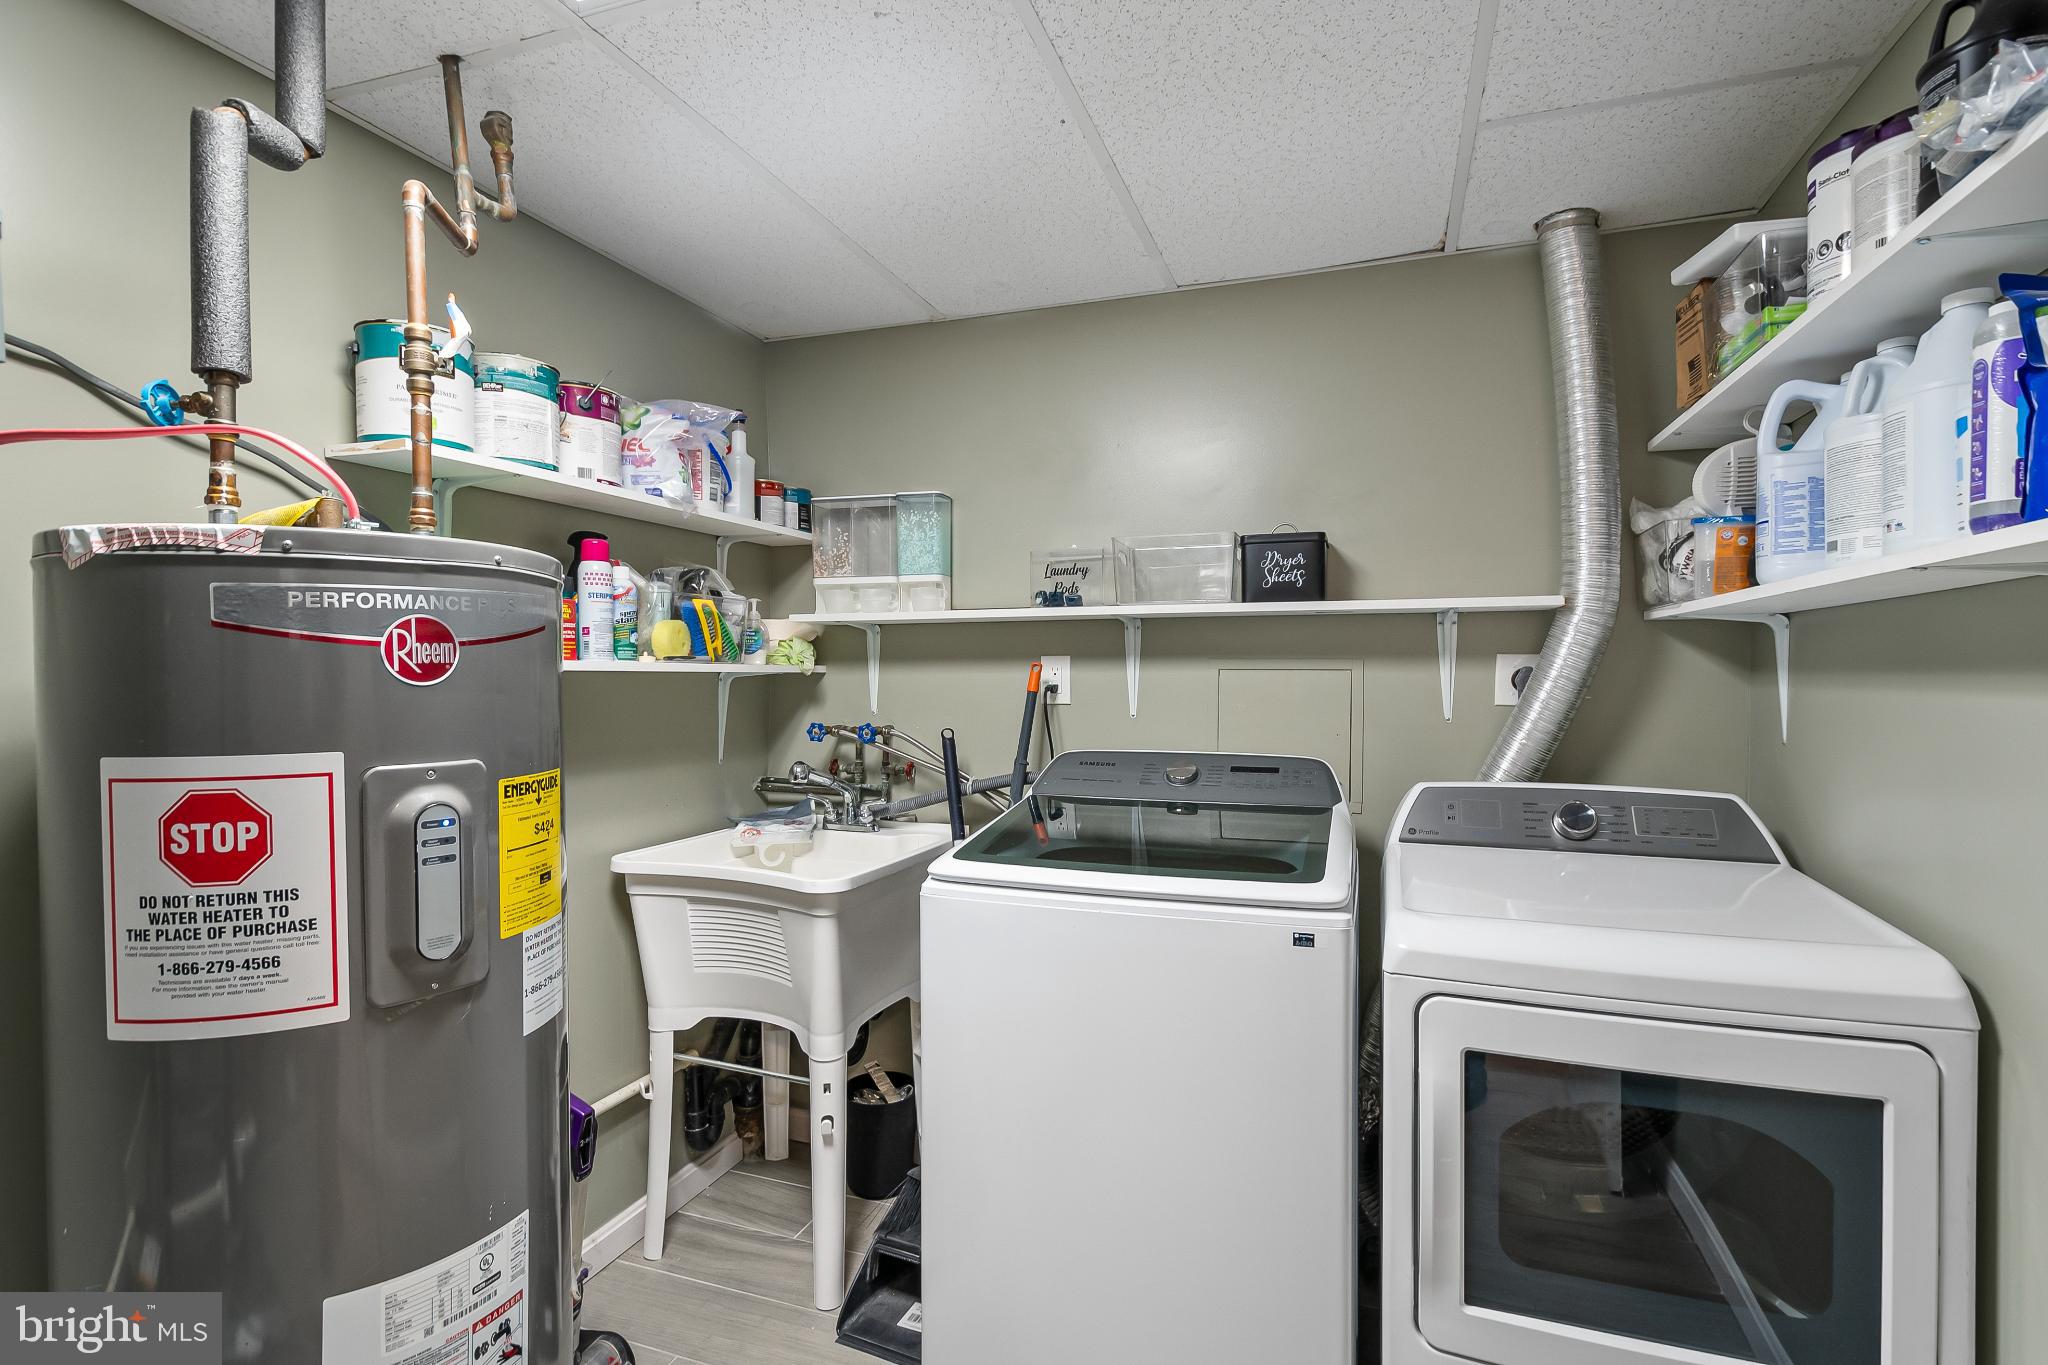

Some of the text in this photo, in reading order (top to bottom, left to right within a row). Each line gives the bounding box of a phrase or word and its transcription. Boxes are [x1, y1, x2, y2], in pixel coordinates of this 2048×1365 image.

[1818, 168, 1850, 186] Sani-Clot
[1044, 562, 1089, 580] Laundry
[1261, 551, 1306, 572] Dryer
[1263, 565, 1306, 587] Sheets
[1052, 581, 1080, 597] Pods
[287, 591, 473, 612] PERFORMANCE
[392, 618, 455, 673] Rheem
[504, 775, 558, 799] ENERGYGUIDE
[534, 817, 554, 835] $424
[170, 821, 259, 855] STOP
[139, 887, 300, 909] DO NOT RETURN THIS
[148, 905, 289, 926] WATER HEATER TO
[126, 918, 318, 942] THE PLACE OF PURCHASE
[534, 930, 543, 940] NOT
[250, 944, 281, 953] questions
[158, 955, 281, 976] 1-866-279-4566
[238, 974, 255, 982] days
[239, 980, 263, 988] owner's
[486, 1293, 522, 1323] DANGER
